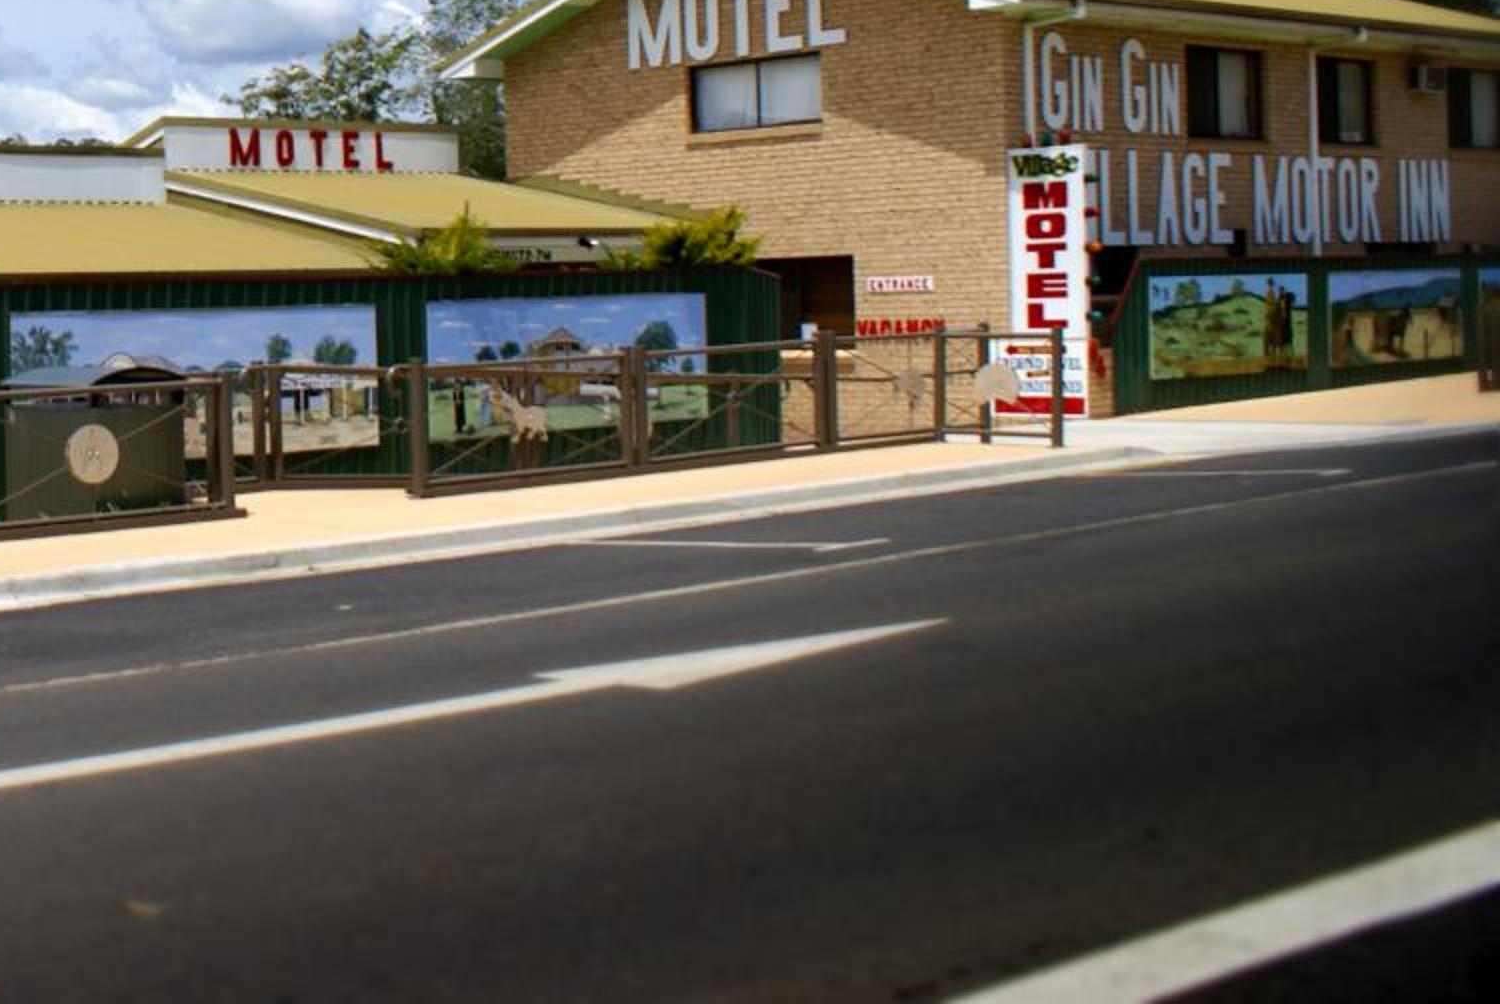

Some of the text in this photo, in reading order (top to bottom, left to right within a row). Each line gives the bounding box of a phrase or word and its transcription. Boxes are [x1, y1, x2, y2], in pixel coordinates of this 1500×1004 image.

[229, 128, 394, 171] MOTEL
[1086, 147, 1451, 245] ILLAGE MOTOR INN
[869, 279, 928, 291] ENTRANCE
[1022, 181, 1068, 329] MOTEL
